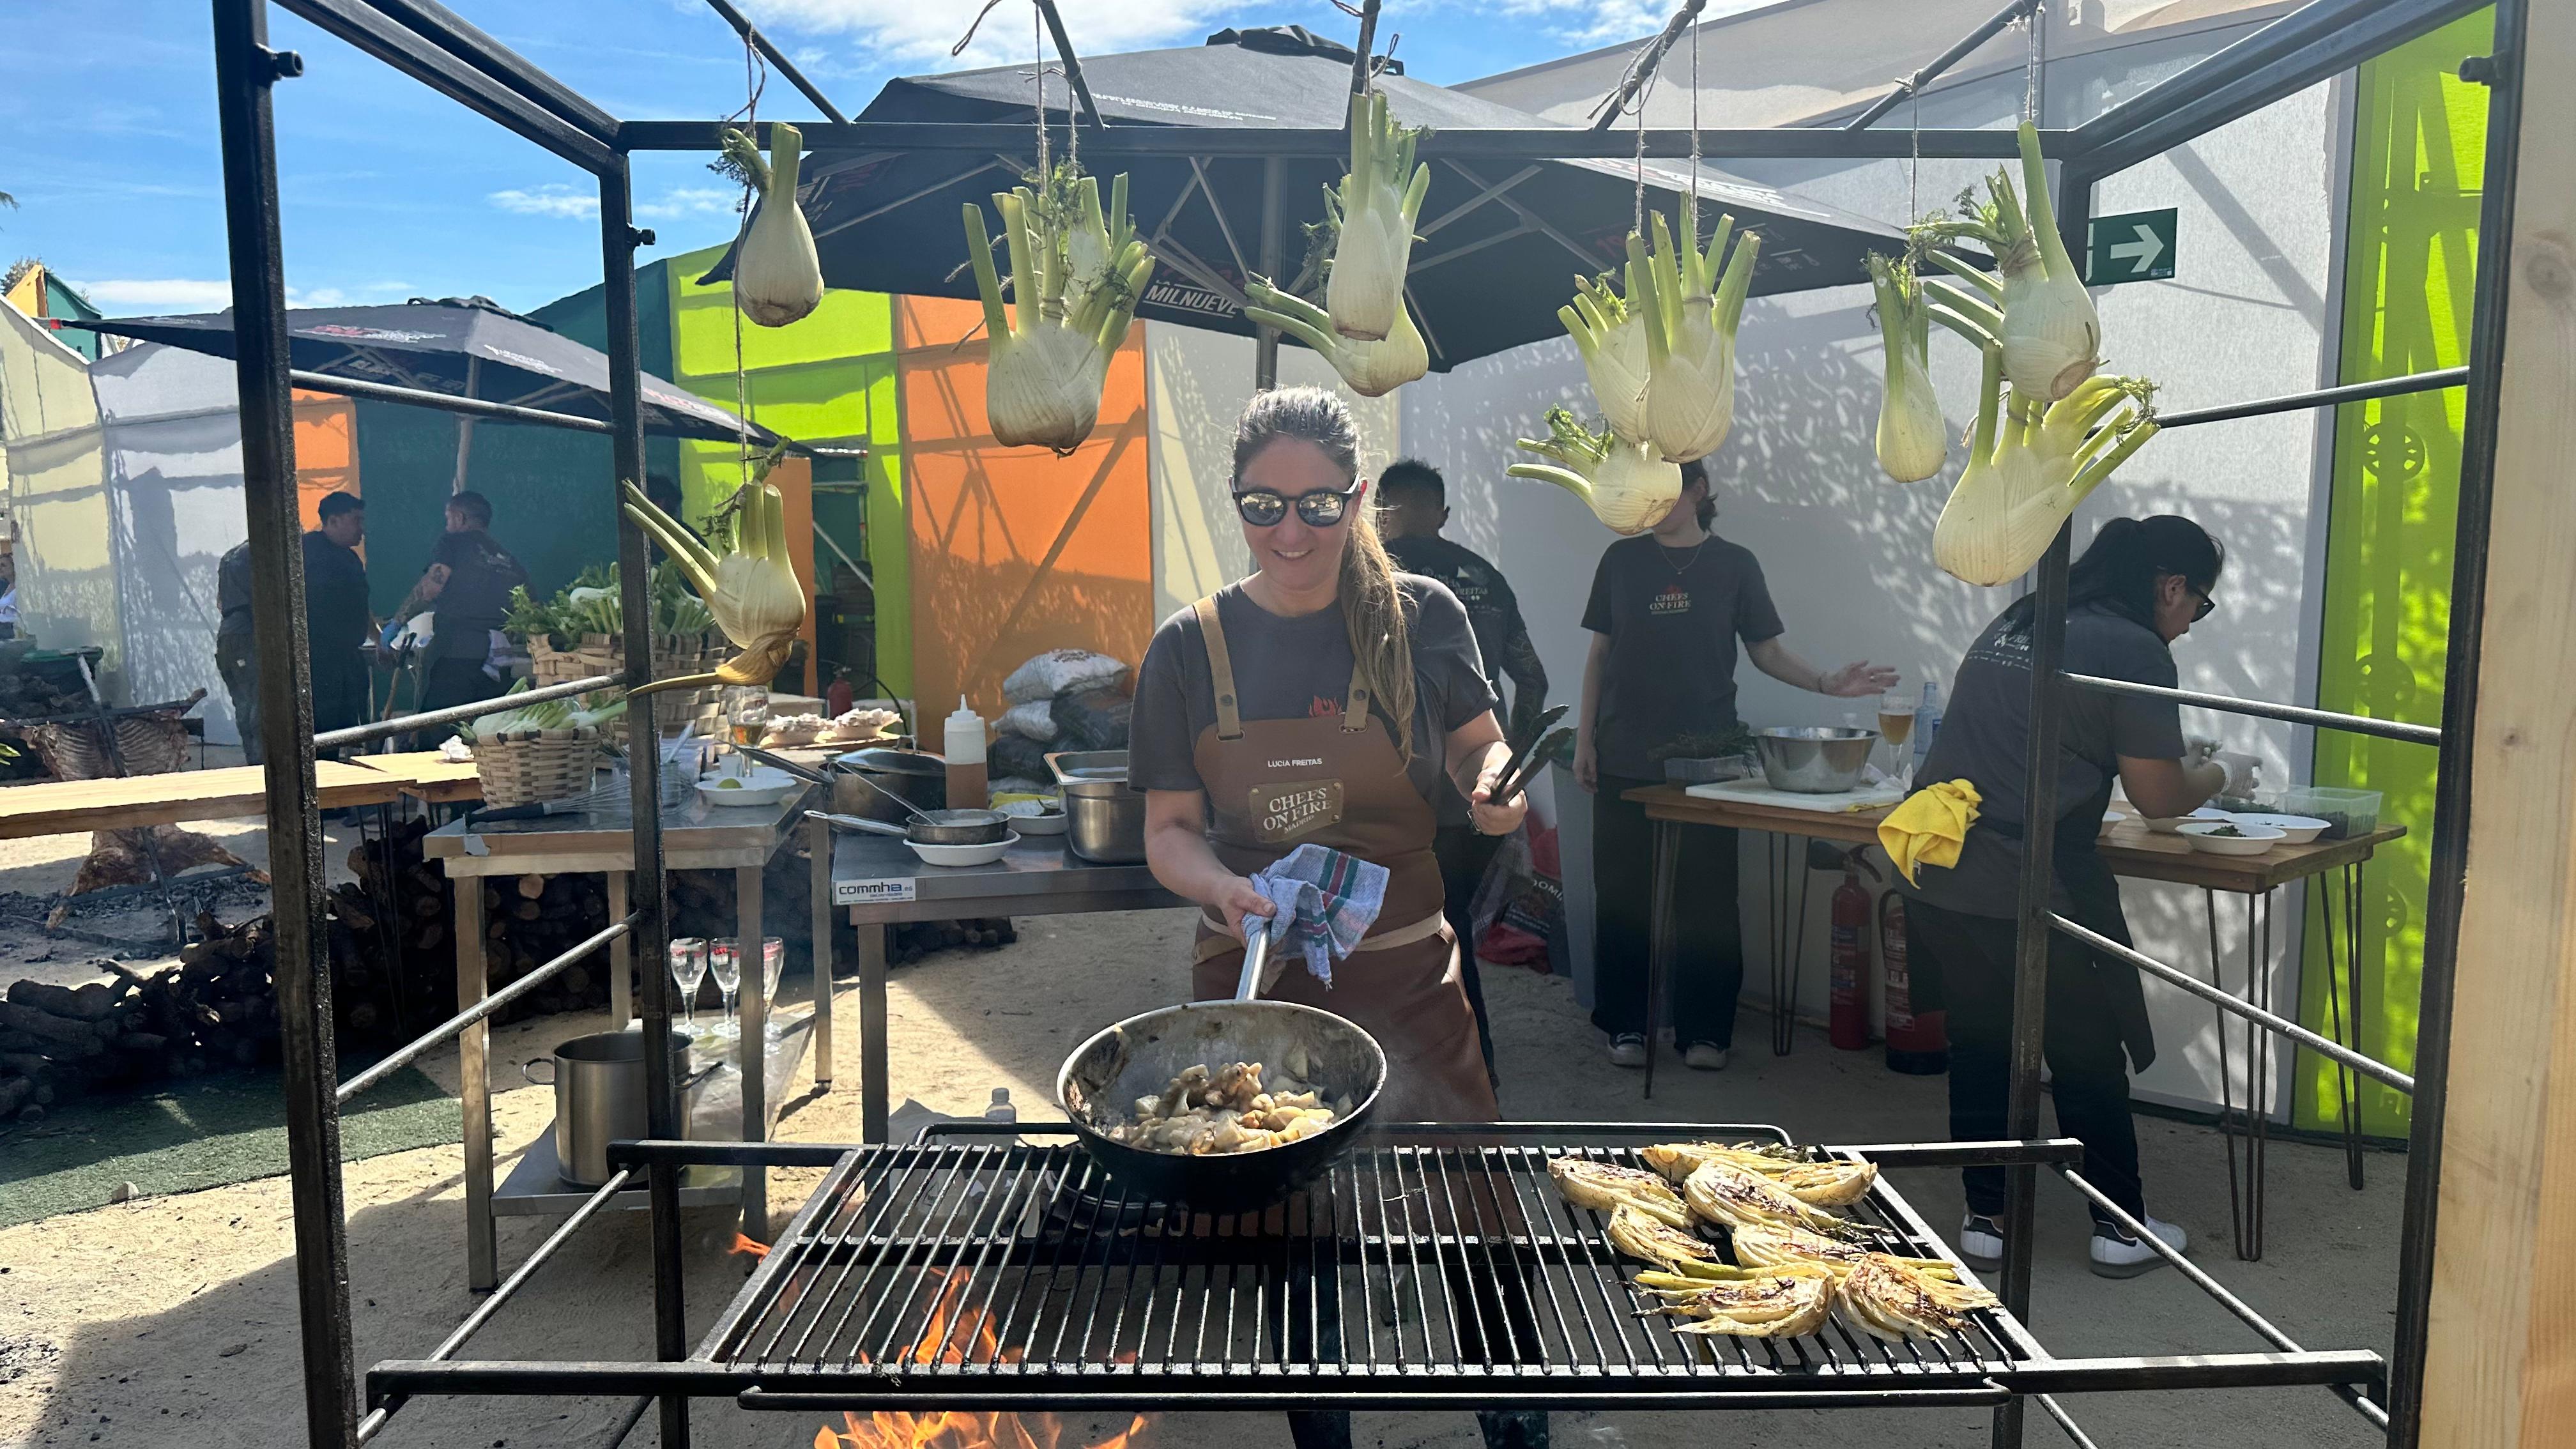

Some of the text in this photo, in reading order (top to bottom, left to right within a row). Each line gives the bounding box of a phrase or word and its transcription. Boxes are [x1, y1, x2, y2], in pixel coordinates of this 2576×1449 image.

[1268, 758, 1322, 767] LUCIA FREITAS
[1269, 787, 1327, 813] CHEFS
[1263, 799, 1333, 831] ON FIRE
[1284, 815, 1314, 834] MADRID
